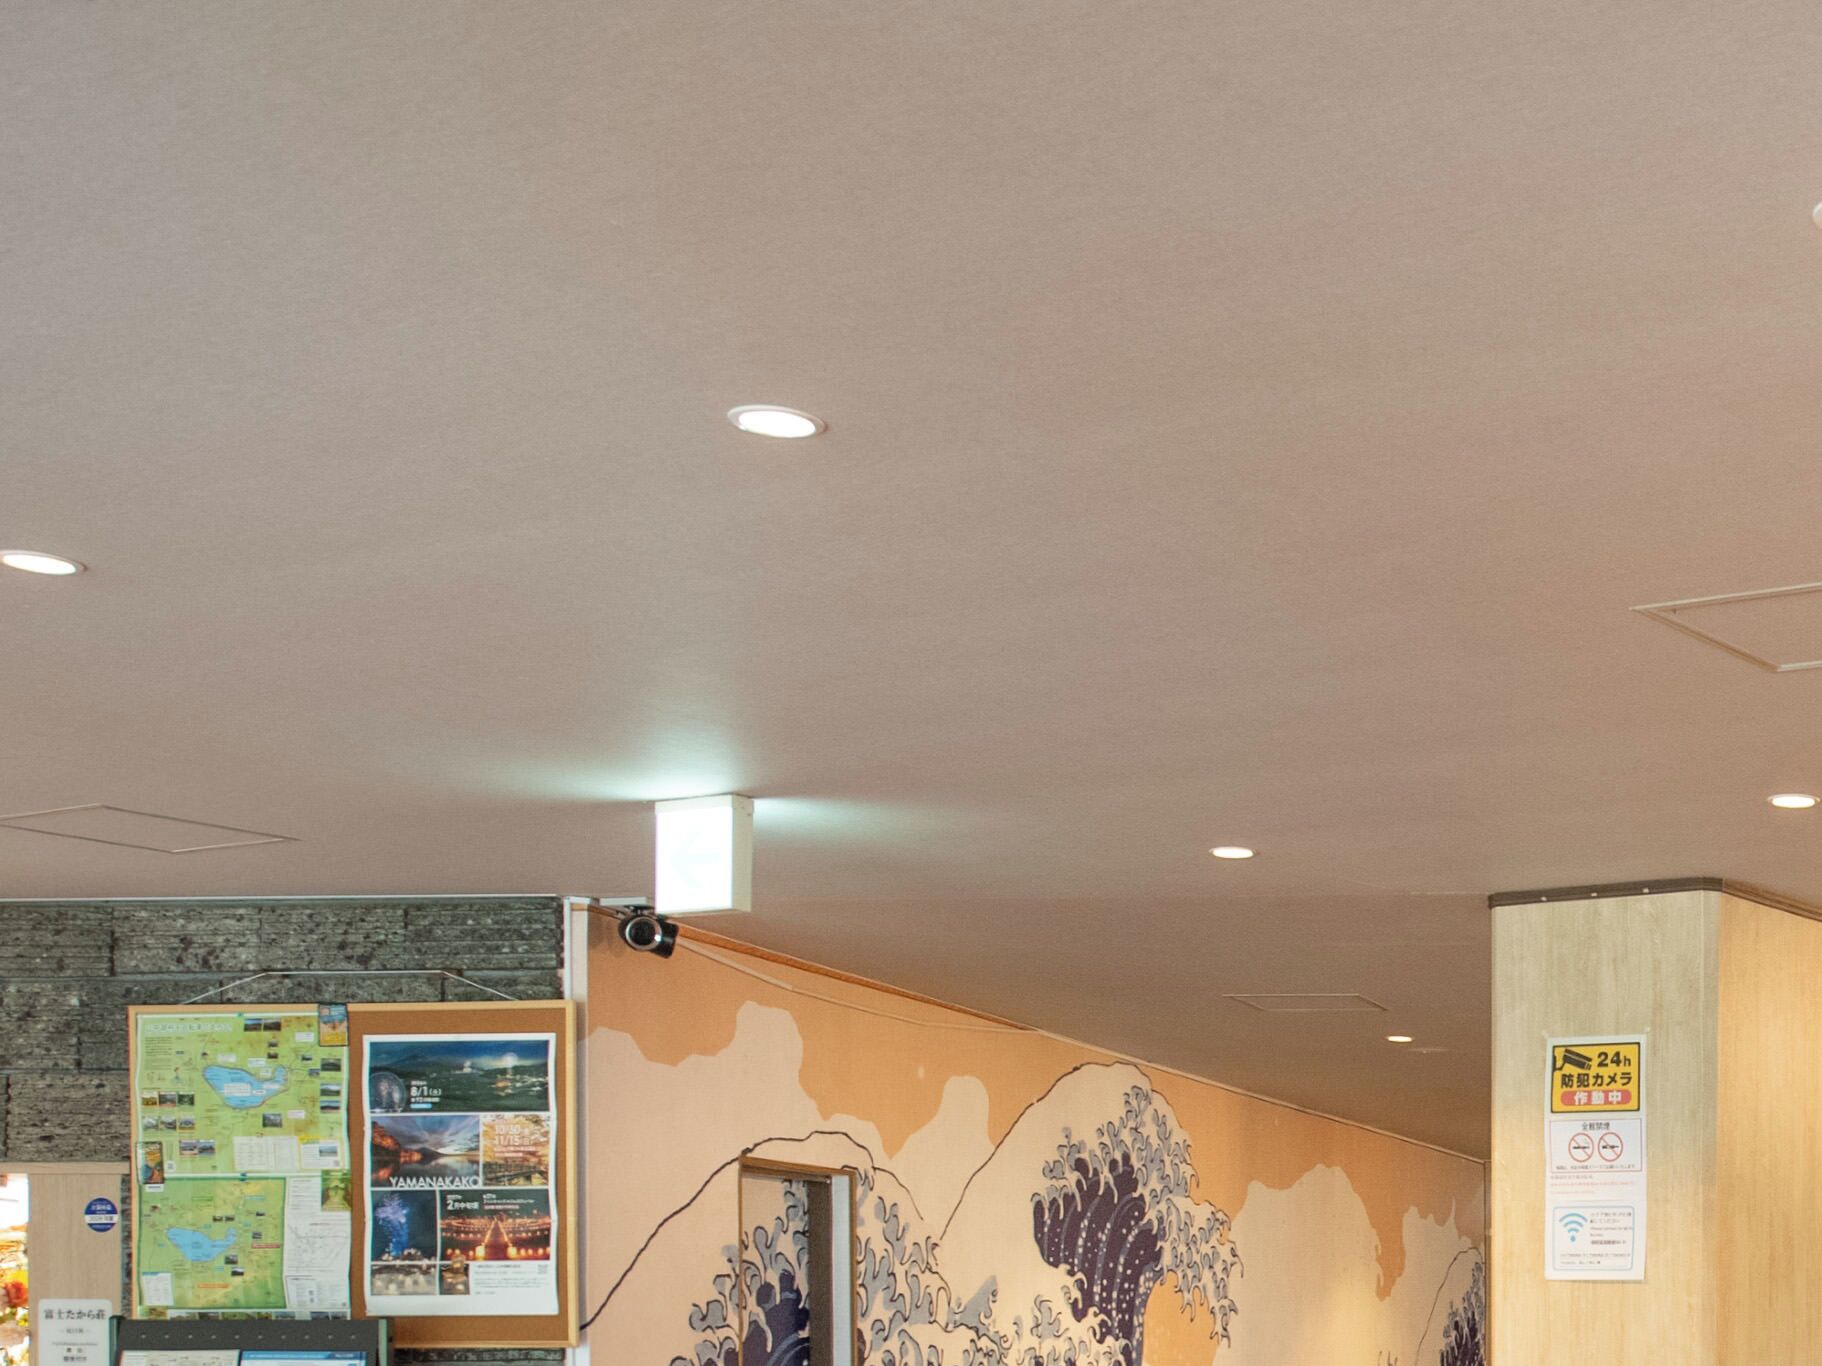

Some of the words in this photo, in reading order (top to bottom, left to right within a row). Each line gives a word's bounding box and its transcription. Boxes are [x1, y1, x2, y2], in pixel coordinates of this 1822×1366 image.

[1597, 1051, 1631, 1068] 24h
[1561, 1072, 1632, 1088] 防犯カメラ
[1574, 1091, 1622, 1105] 作動中
[389, 1176, 480, 1188] YAMANAKAKO
[44, 1309, 106, 1320] 富士たから荘
